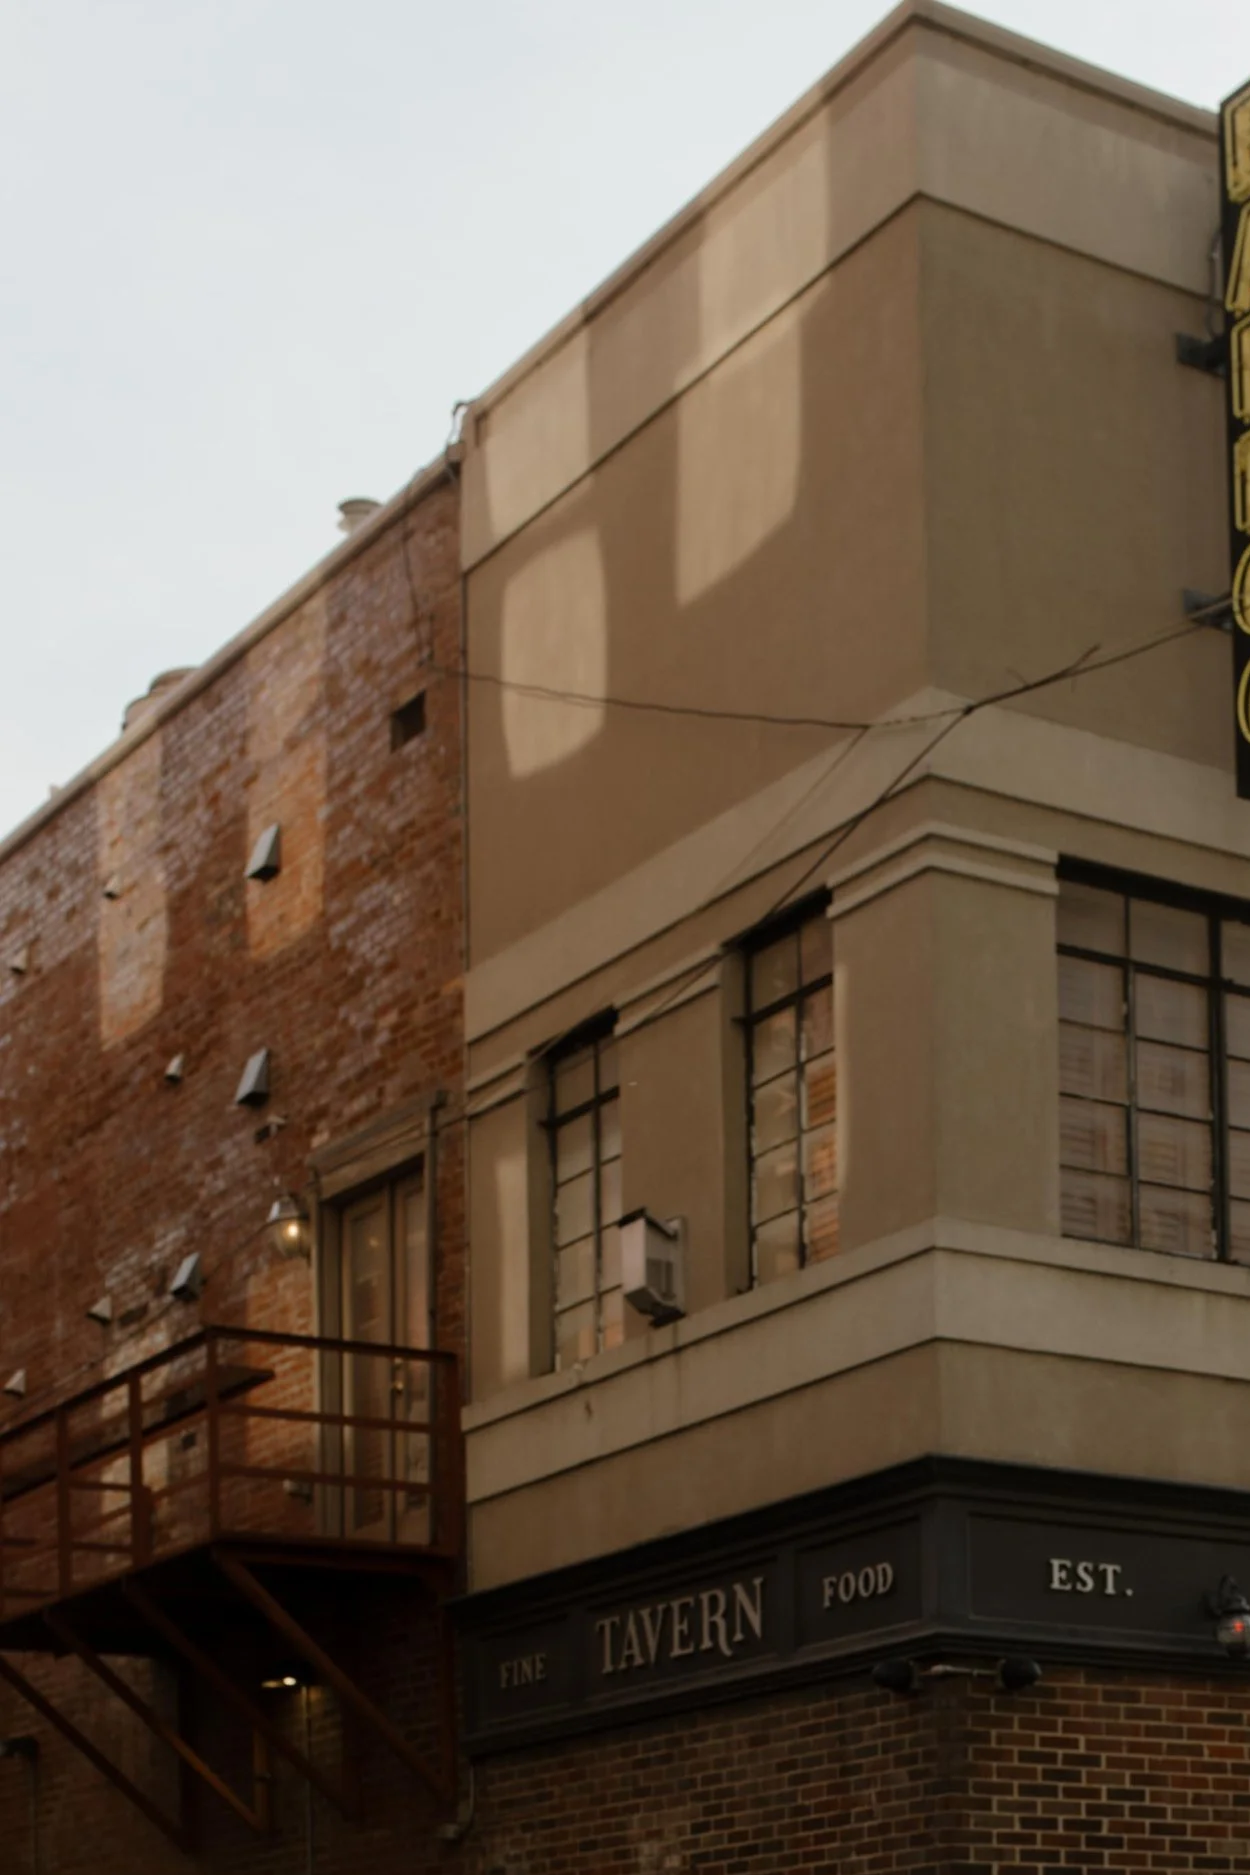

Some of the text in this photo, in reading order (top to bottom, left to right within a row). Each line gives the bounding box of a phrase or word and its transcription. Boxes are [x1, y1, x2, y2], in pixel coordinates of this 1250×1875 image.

[1049, 1558, 1134, 1597] EST.
[498, 1562, 894, 1689] FINE TAVERN FOOD
